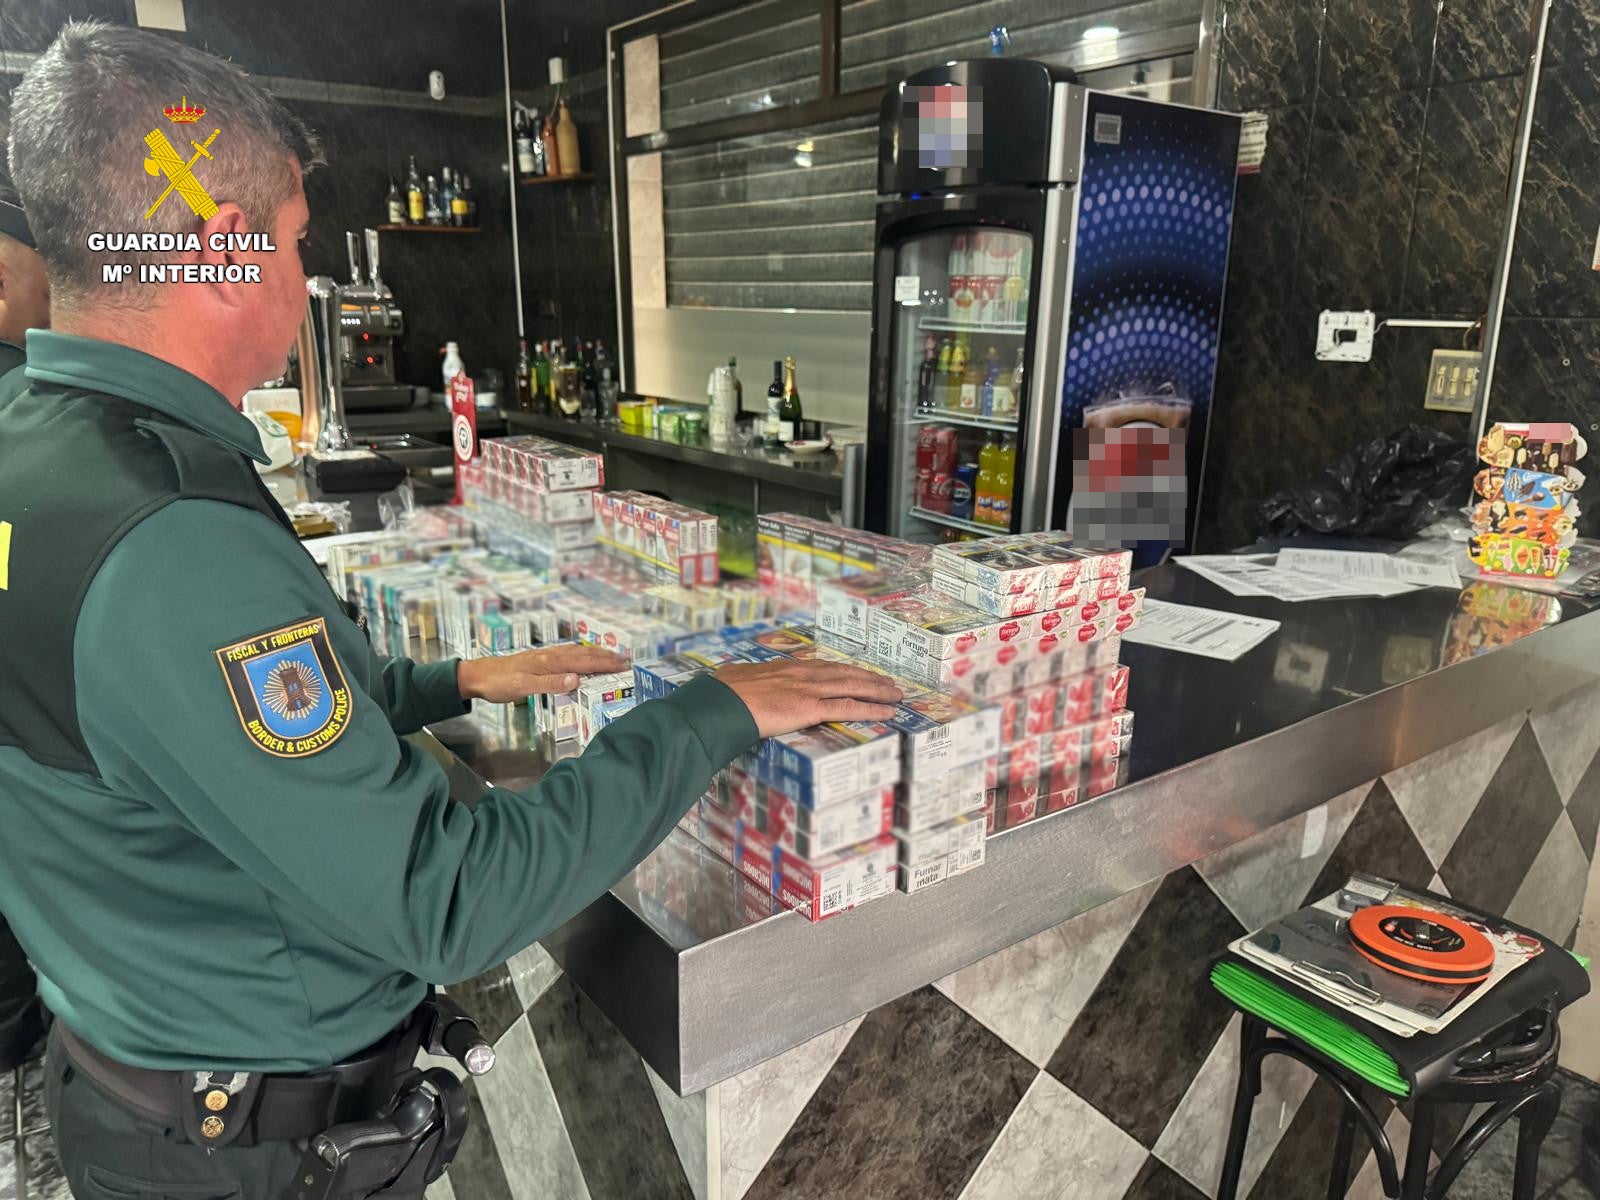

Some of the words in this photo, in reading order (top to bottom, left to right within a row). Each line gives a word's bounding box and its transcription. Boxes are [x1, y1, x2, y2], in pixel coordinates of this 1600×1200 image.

[226, 643, 260, 663] FISCAL
[261, 640, 269, 650] Y
[271, 624, 320, 648] FRONTERAS
[902, 636, 929, 655] Fortuna
[248, 719, 284, 752] BORDER
[286, 742, 295, 753] &
[296, 721, 340, 752] CUSTOMS
[333, 687, 348, 723] POLICE
[914, 863, 942, 879] Fumar
[916, 873, 938, 888] mata
